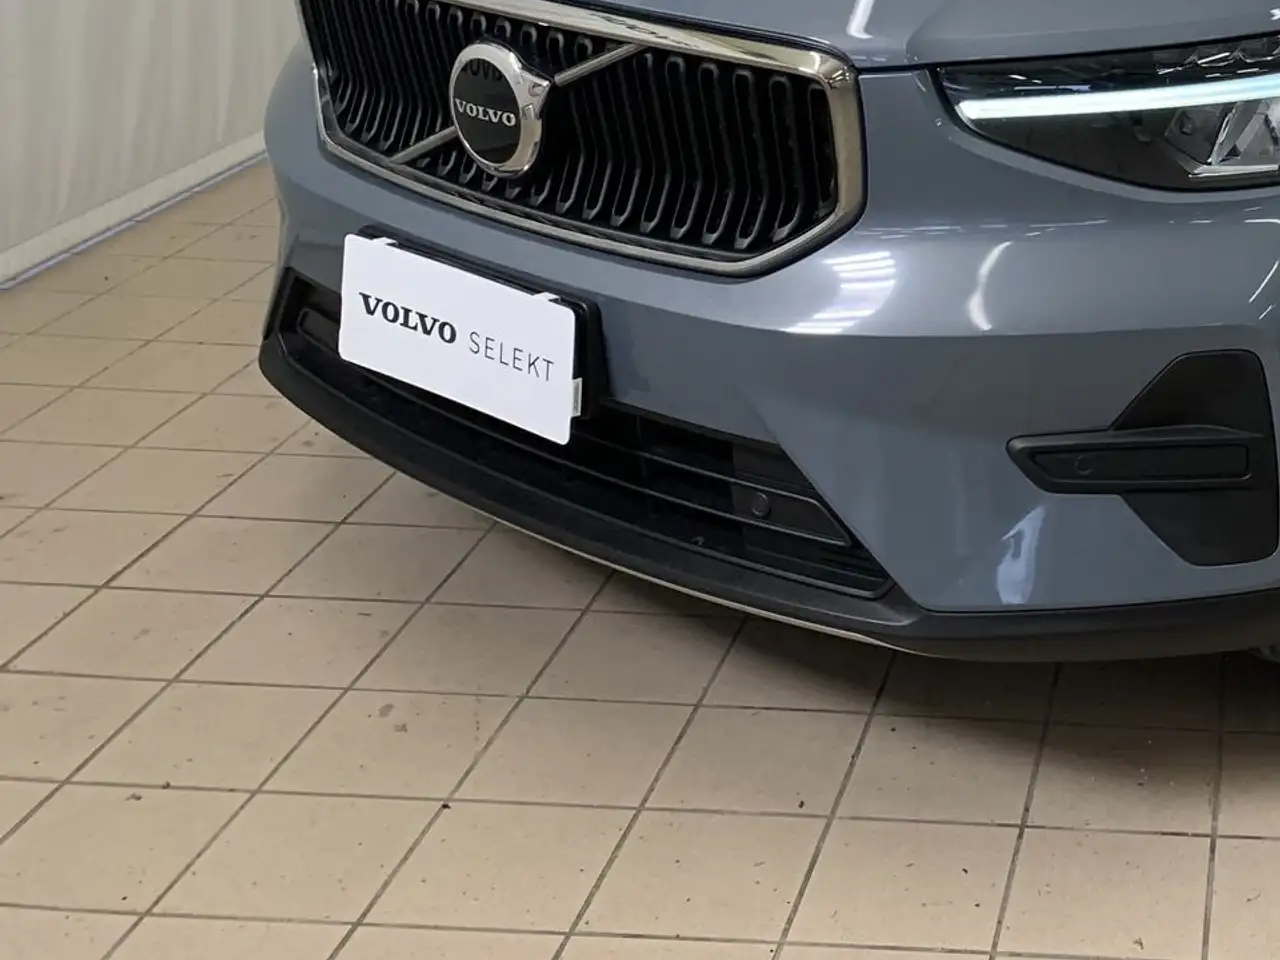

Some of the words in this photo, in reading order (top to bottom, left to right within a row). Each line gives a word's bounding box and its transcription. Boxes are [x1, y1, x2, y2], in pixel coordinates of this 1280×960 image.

[455, 98, 516, 127] VOLVO
[359, 292, 457, 344] VOLVO
[469, 331, 554, 382] SELEKT
